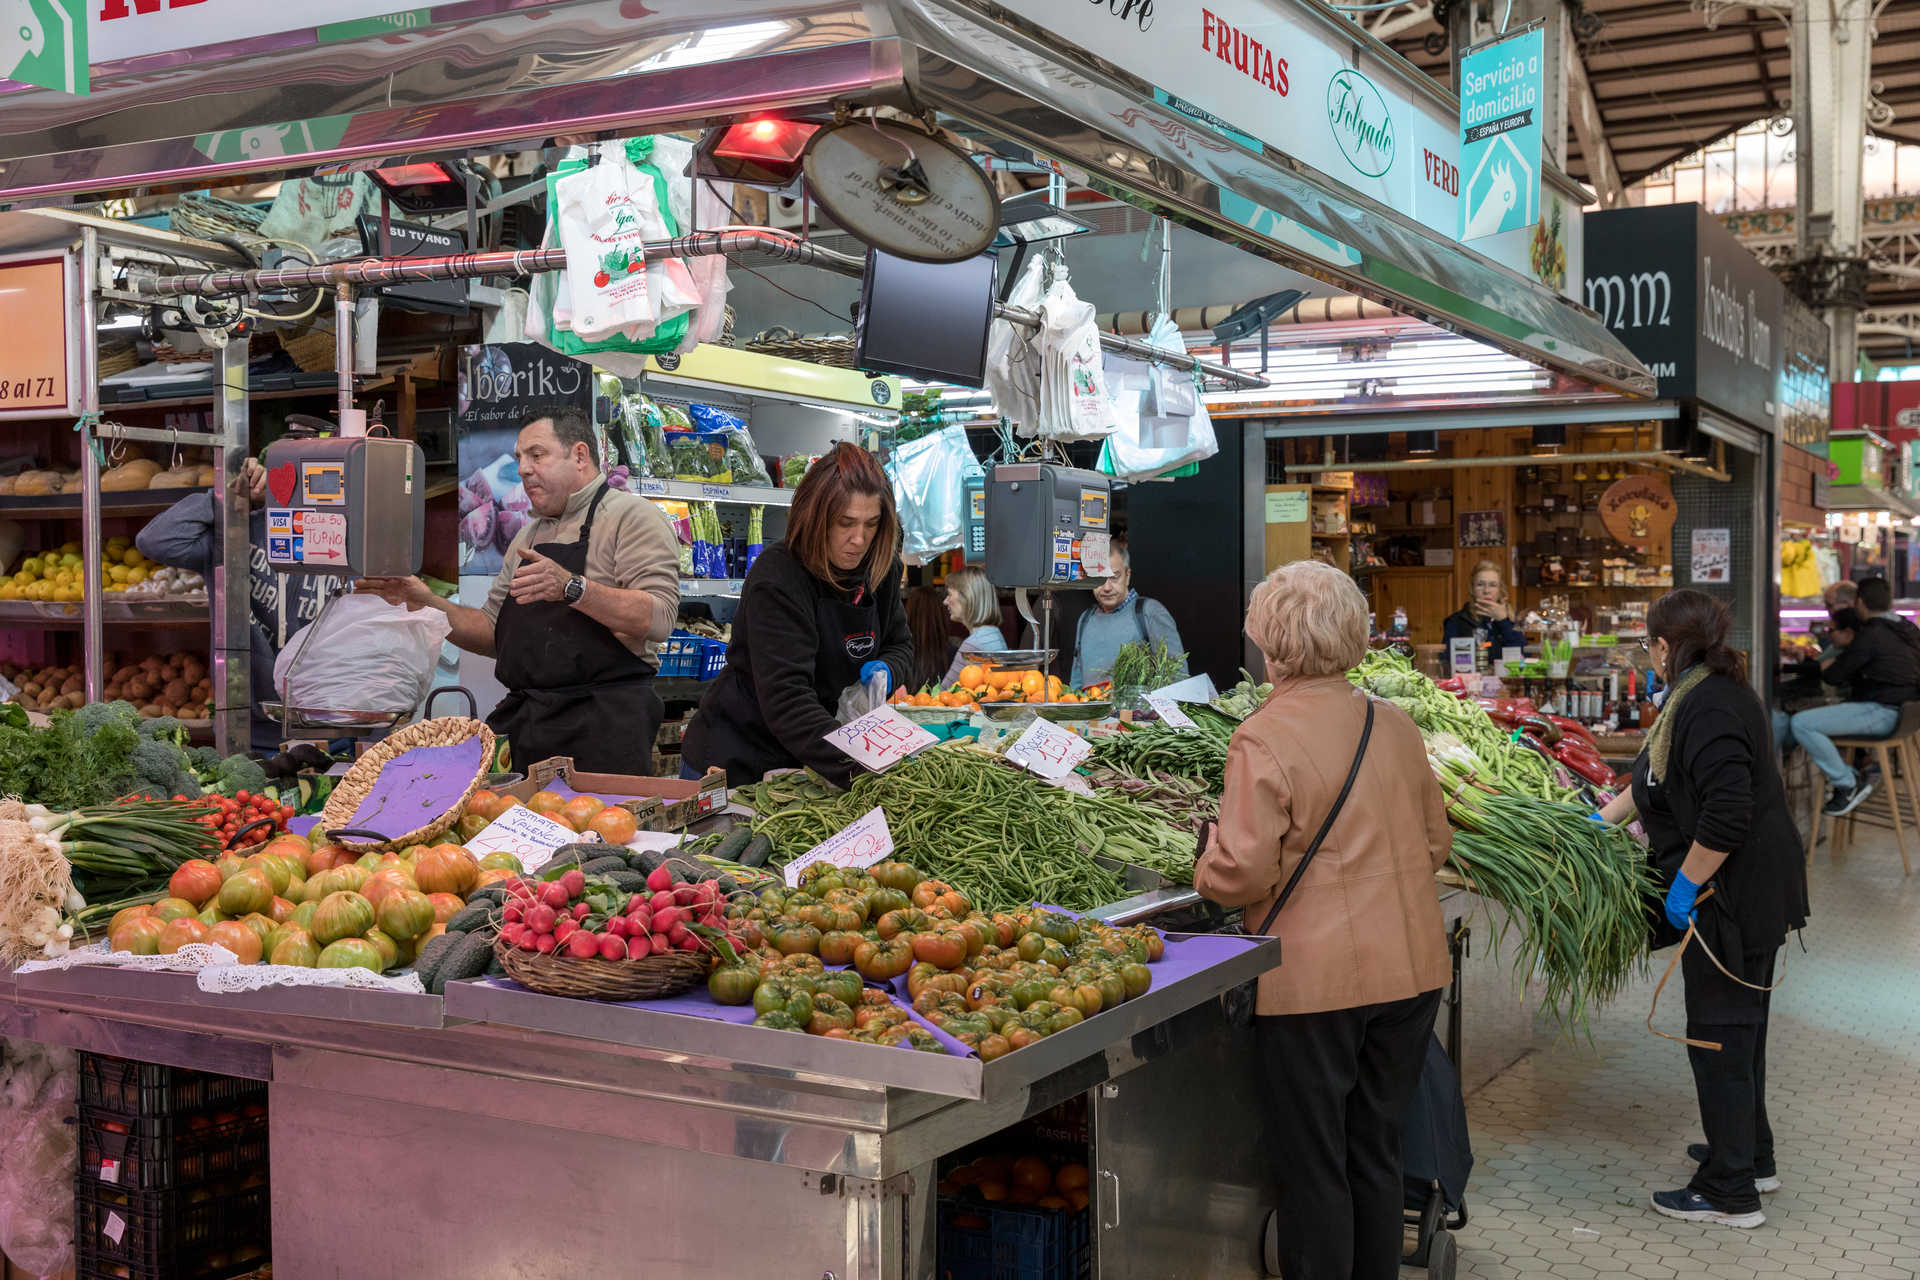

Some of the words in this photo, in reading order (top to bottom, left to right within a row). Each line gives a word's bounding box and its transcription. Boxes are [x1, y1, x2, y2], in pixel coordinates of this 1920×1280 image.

[1201, 8, 1289, 97] FRUTAS
[1465, 57, 1525, 96] Servicio
[1528, 56, 1537, 73] a
[1466, 85, 1536, 124] domicilio
[1479, 123, 1500, 138] ESPAÑA
[1504, 115, 1526, 131] EUROPA
[389, 226, 406, 238] SU
[408, 230, 451, 246] TURNO
[36, 376, 55, 398] 71
[480, 405, 506, 421] sabor
[507, 405, 520, 419] de
[272, 517, 287, 527] VISA
[1057, 545, 1068, 553] VISA
[512, 806, 560, 832] TOMATE
[511, 817, 567, 845] VALENCIA
